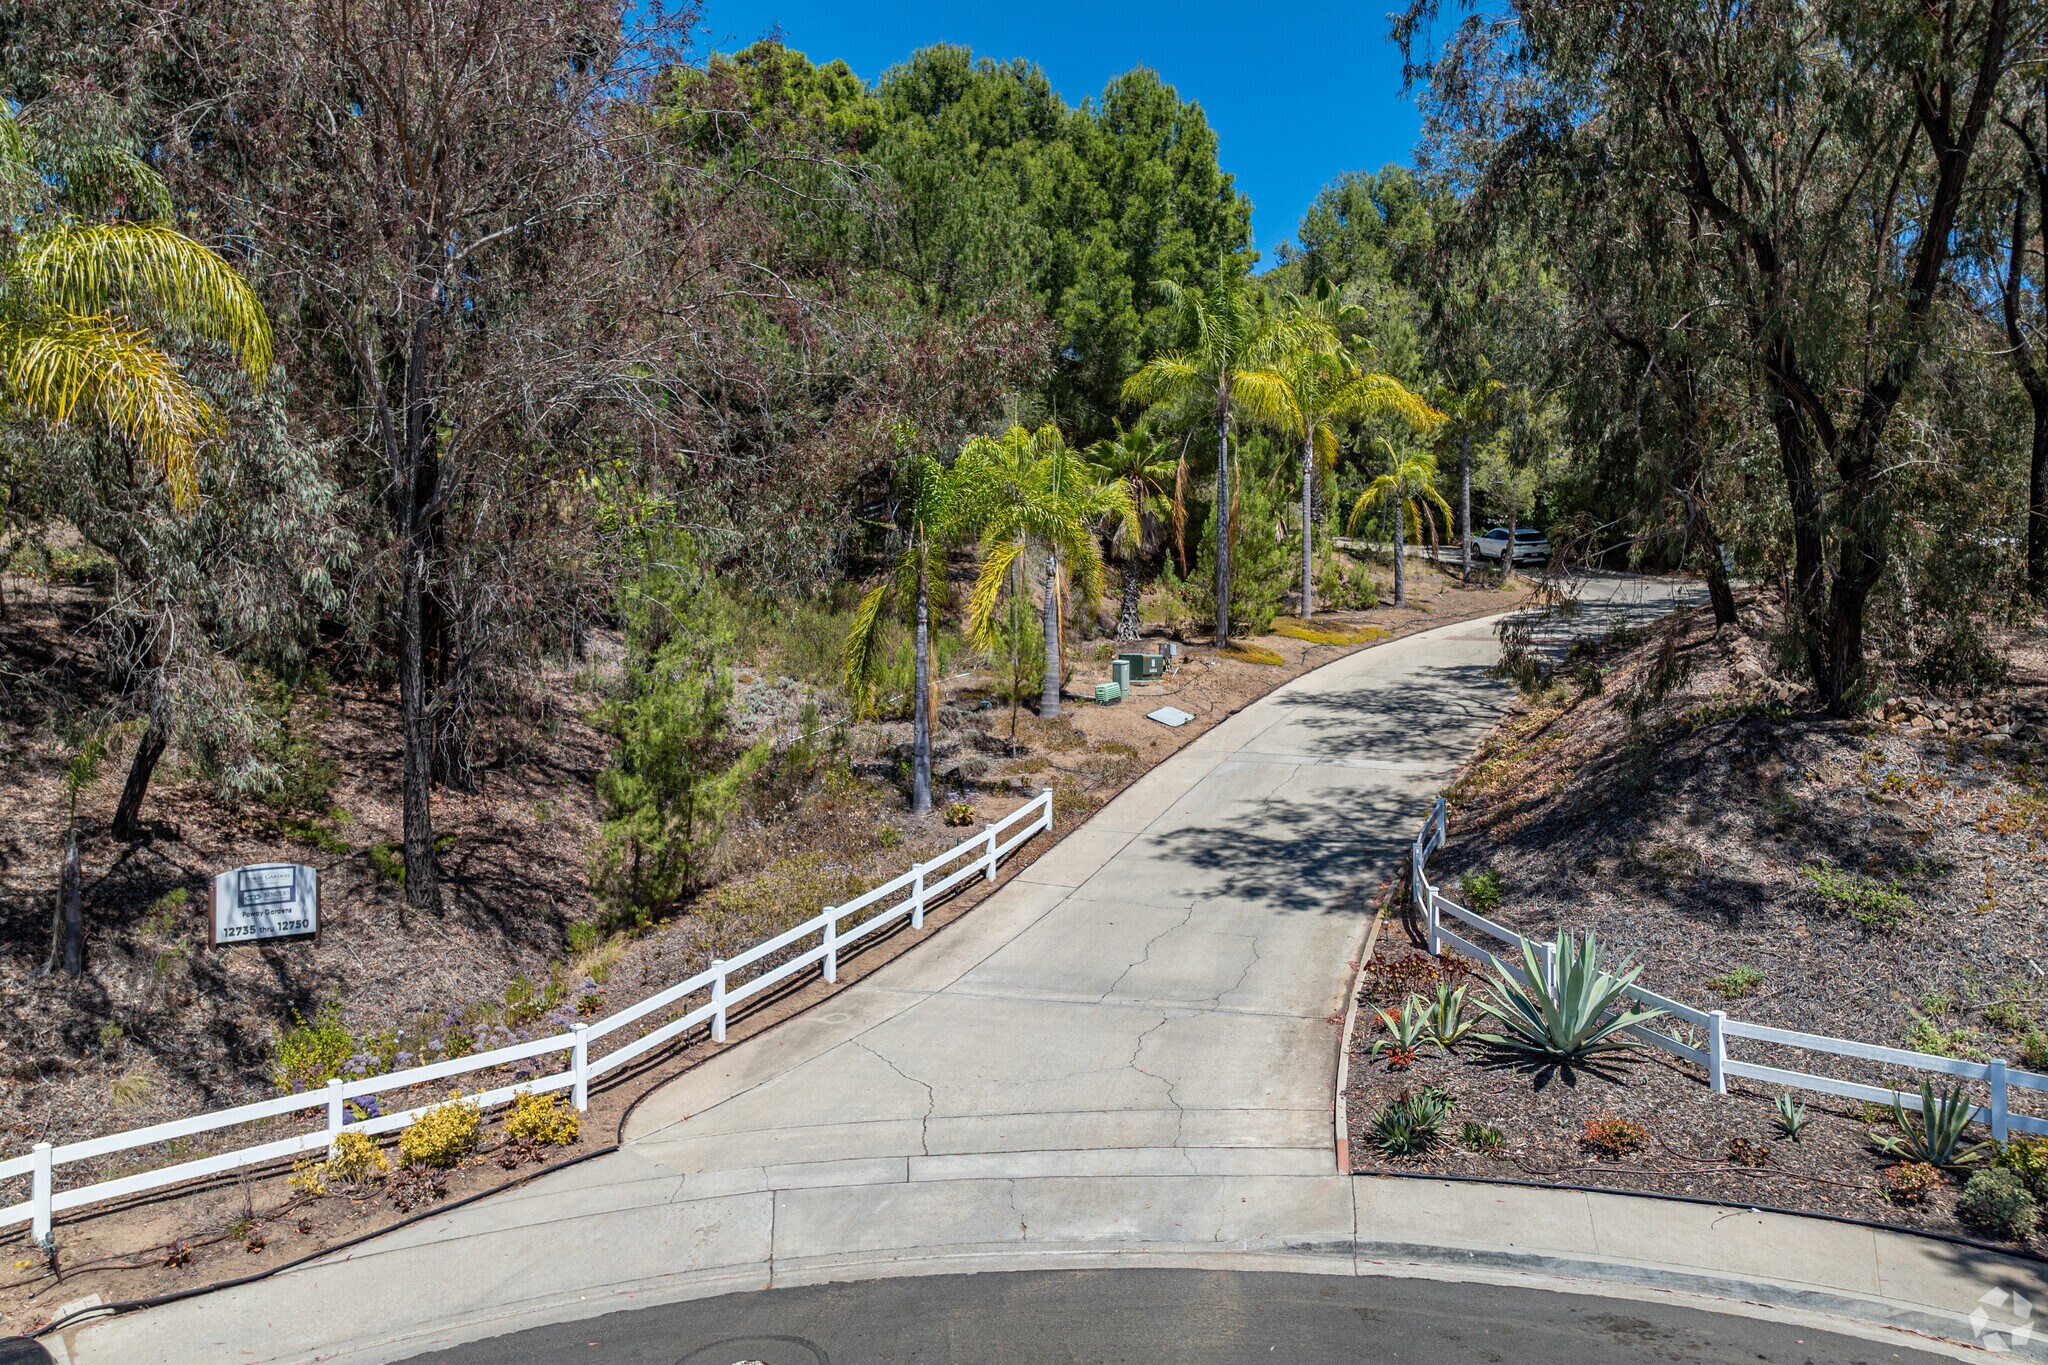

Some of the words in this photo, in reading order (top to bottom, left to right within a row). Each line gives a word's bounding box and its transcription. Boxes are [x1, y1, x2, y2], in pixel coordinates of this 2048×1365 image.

[265, 907, 292, 916] Gardens
[223, 925, 256, 937] 12735
[259, 926, 275, 934] thru
[277, 919, 310, 931] 12750
